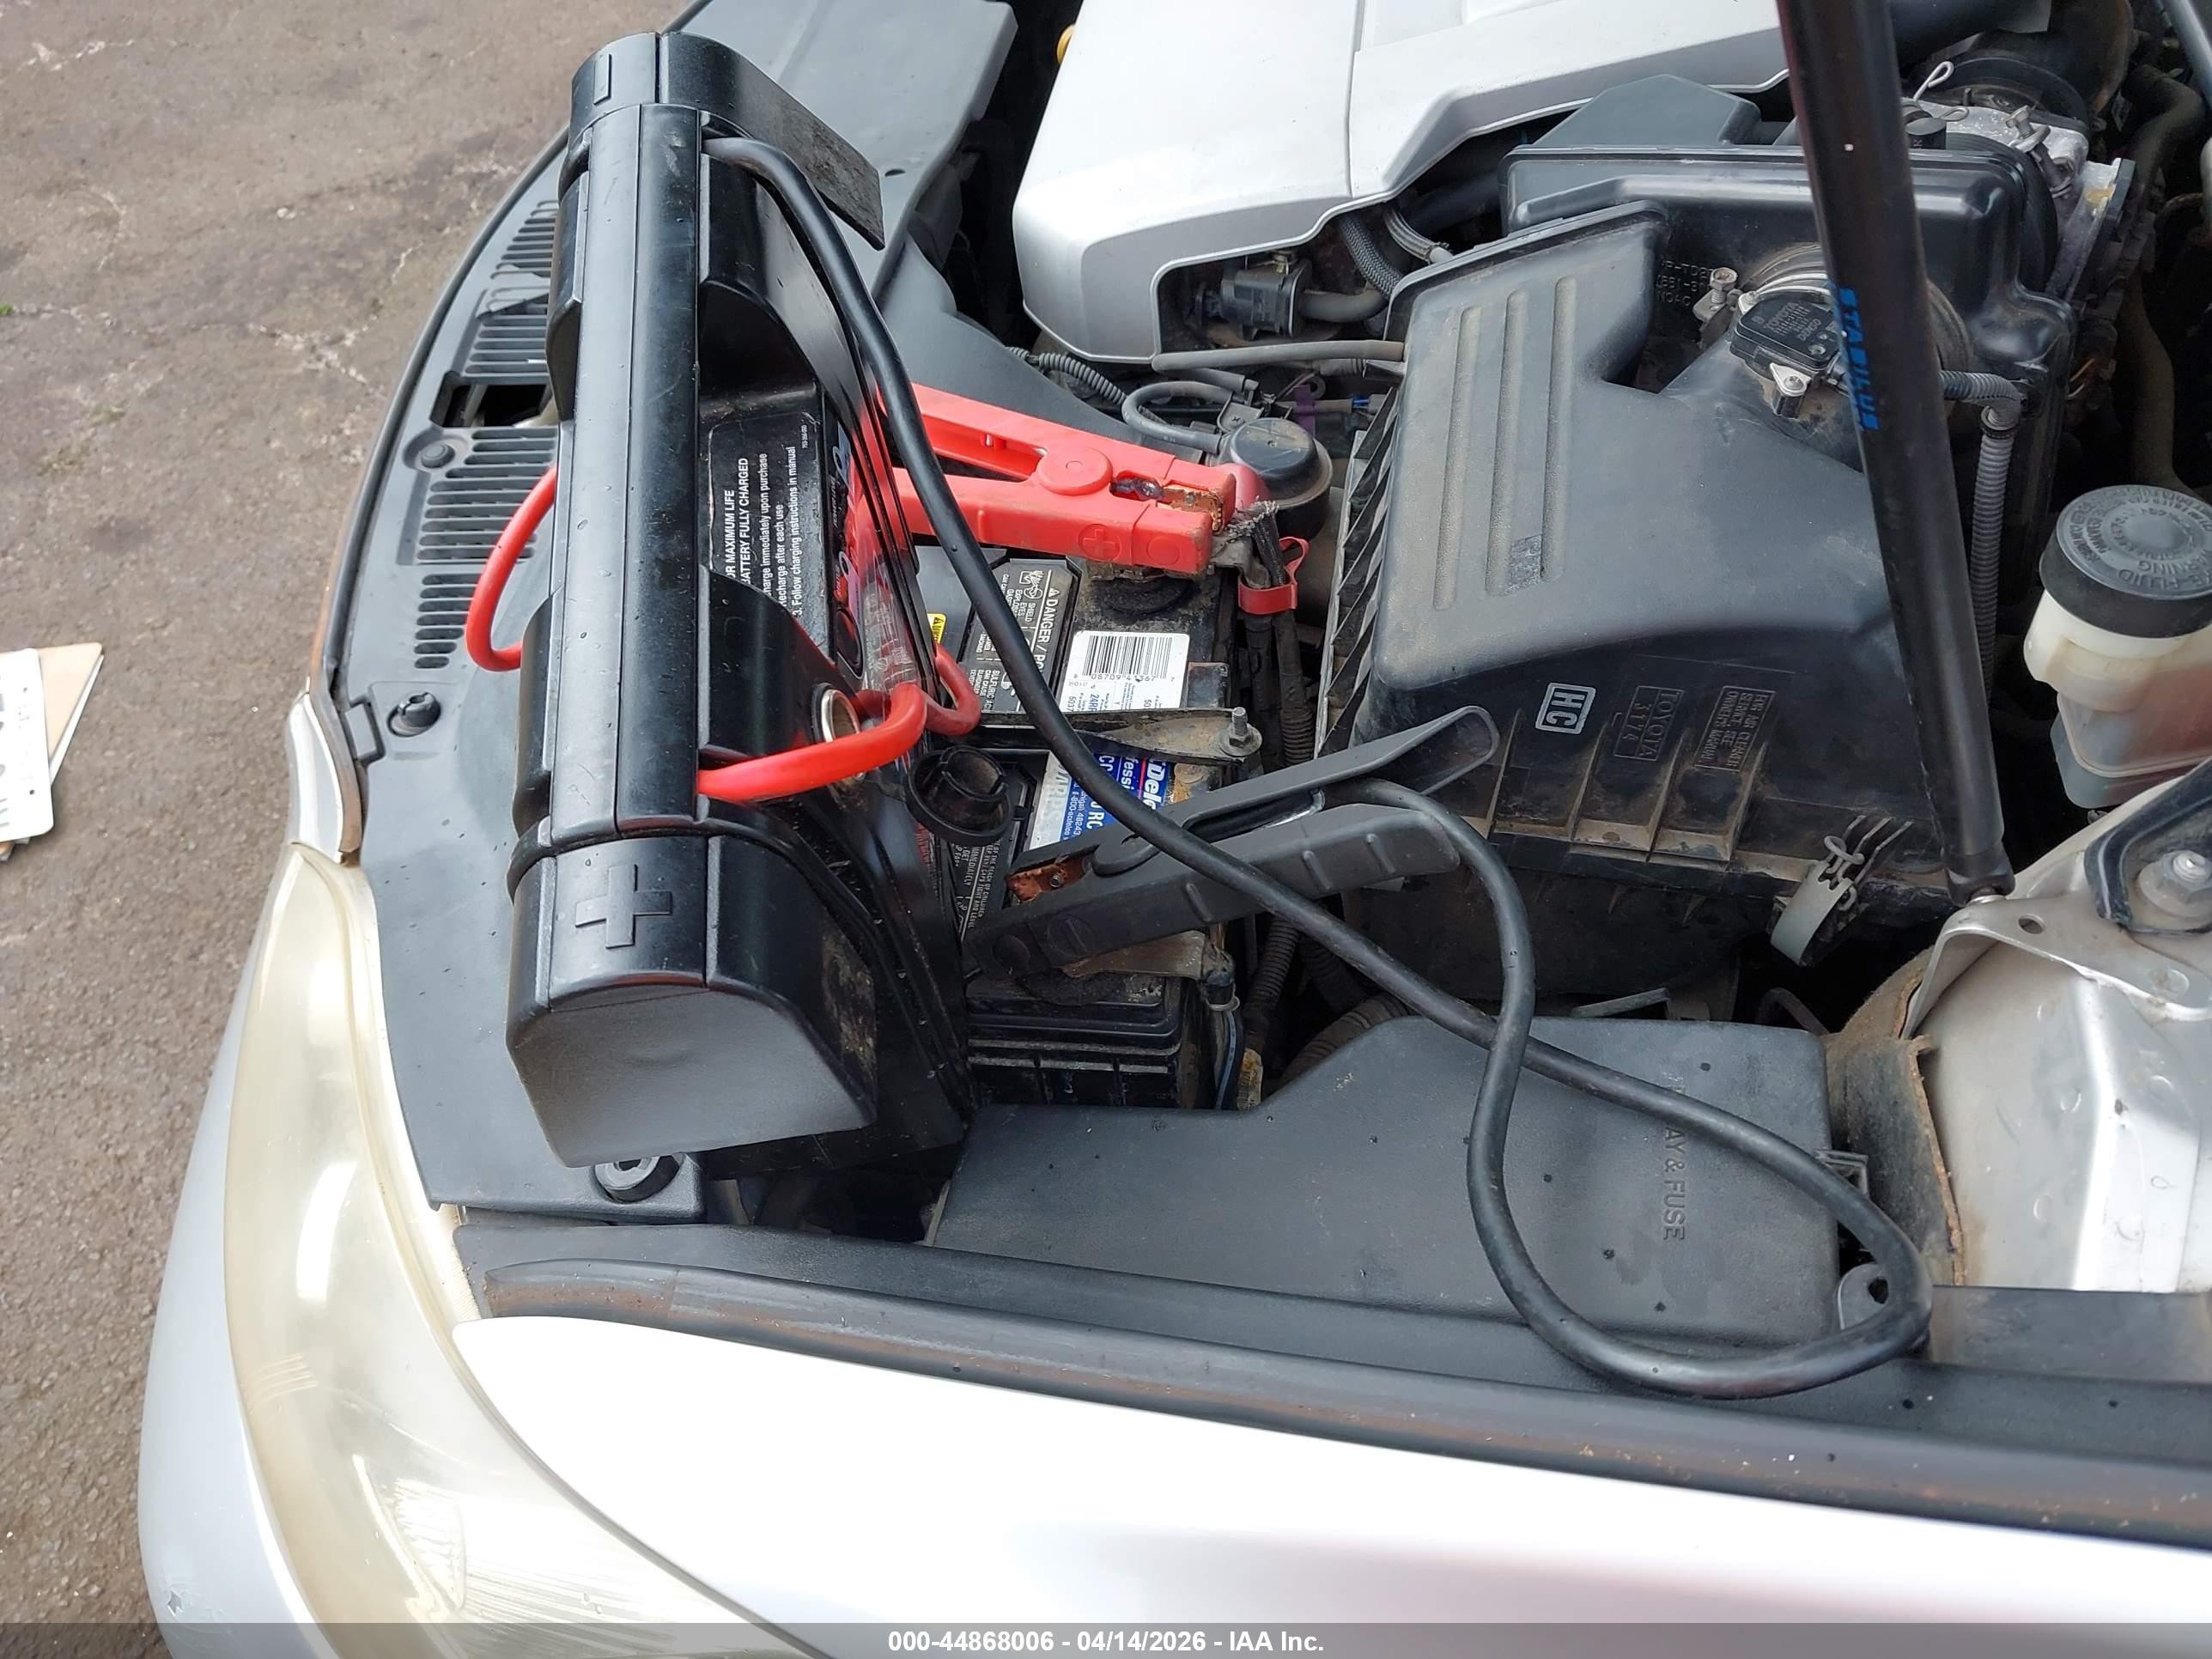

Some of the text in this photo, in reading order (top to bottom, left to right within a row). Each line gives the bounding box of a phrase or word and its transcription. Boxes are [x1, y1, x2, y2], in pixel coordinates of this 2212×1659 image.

[757, 453, 771, 491] purchase
[786, 447, 797, 477] manual
[738, 458, 750, 507] CHARGED
[787, 477, 798, 486] in
[724, 489, 735, 511] LIFE
[761, 492, 771, 514] upon
[775, 505, 784, 520] use
[788, 487, 799, 536] instructions
[738, 507, 750, 538] FULLY
[774, 521, 785, 542] each
[724, 514, 736, 563] MAXIMUM
[758, 515, 771, 567] immediately
[775, 544, 786, 564] after
[790, 537, 802, 574] charging
[791, 576, 803, 606] Follow
[1018, 602, 1028, 617] EYES
[1024, 602, 1036, 623] SHIELD
[1037, 599, 1059, 643] DANGER
[987, 670, 1000, 700] SULFURIC
[1545, 690, 1586, 727] HC
[1638, 690, 1680, 757] TOYOTA
[1720, 692, 1754, 745] SERVICE SEE
[1725, 694, 1770, 767] FOR AIR CLEANER
[1086, 811, 1105, 830] RC
[963, 846, 981, 886] IMMEDIATELY
[978, 869, 988, 883] CAPS
[972, 900, 981, 911] AND
[975, 884, 985, 899] TIGHT
[968, 912, 978, 928] LEVEL
[1664, 1158, 1686, 1173] &
[1662, 1180, 1686, 1241] FUSE
